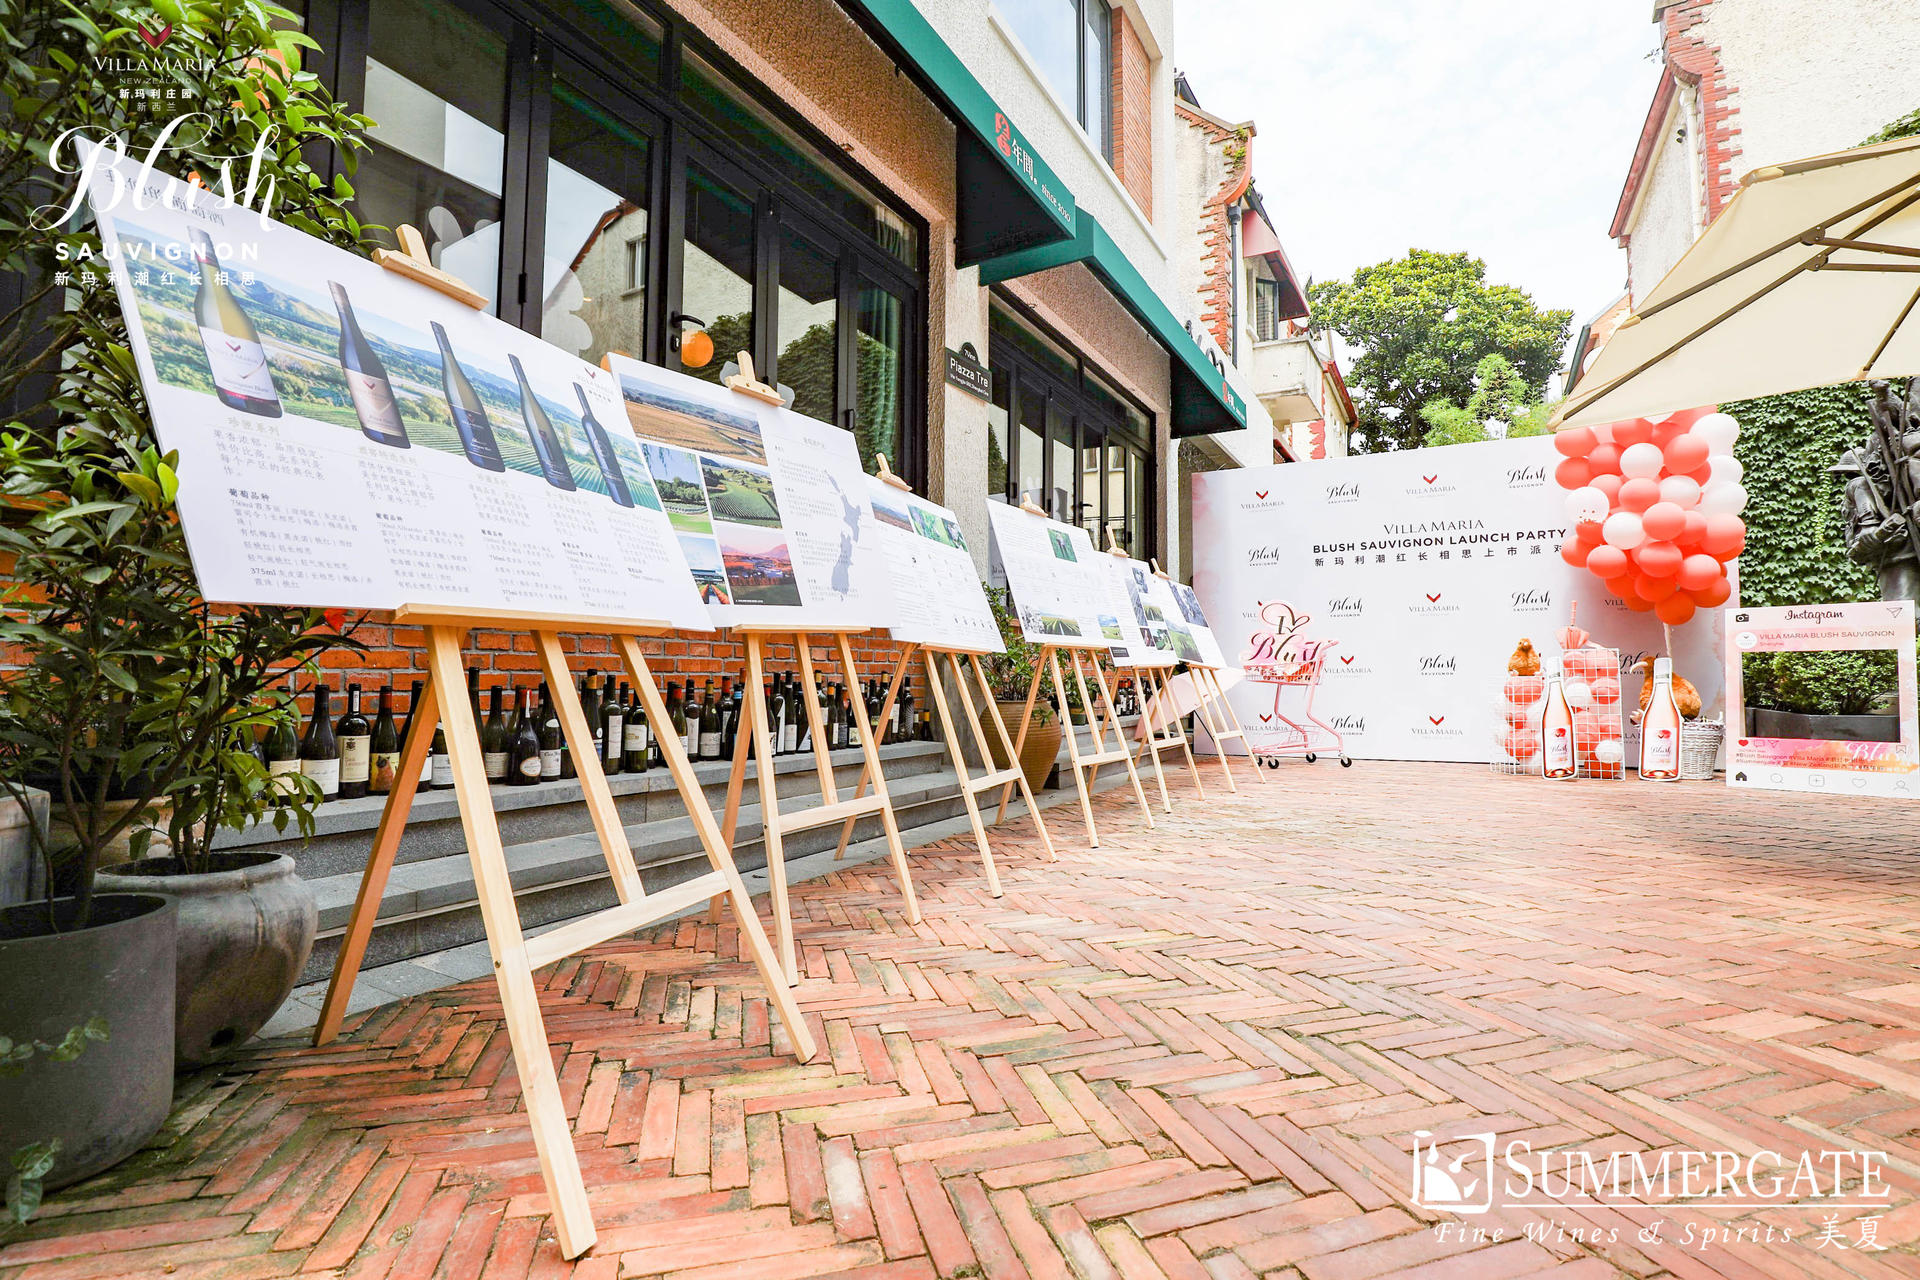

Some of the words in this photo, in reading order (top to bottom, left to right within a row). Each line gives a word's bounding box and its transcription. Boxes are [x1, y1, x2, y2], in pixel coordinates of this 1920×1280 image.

[950, 357, 975, 380] Piazza
[976, 371, 989, 388] Tre
[1507, 465, 1547, 484] Blush
[1326, 483, 1359, 500] Blush
[1384, 523, 1427, 535] VILLA
[1431, 519, 1485, 532] MARIA
[1313, 543, 1355, 553] BLUSH
[1360, 537, 1444, 551] SAUVIGNON
[1449, 532, 1510, 545] LAUNCH
[1516, 529, 1567, 541] PARTY
[1248, 546, 1279, 562] Blush
[1329, 597, 1363, 613] Blush
[1511, 589, 1551, 607] Blush
[1785, 610, 1844, 624] Instagram
[1841, 630, 1895, 638] SAUVIGNON
[1420, 654, 1456, 671] Blush
[1331, 715, 1365, 731] Blush
